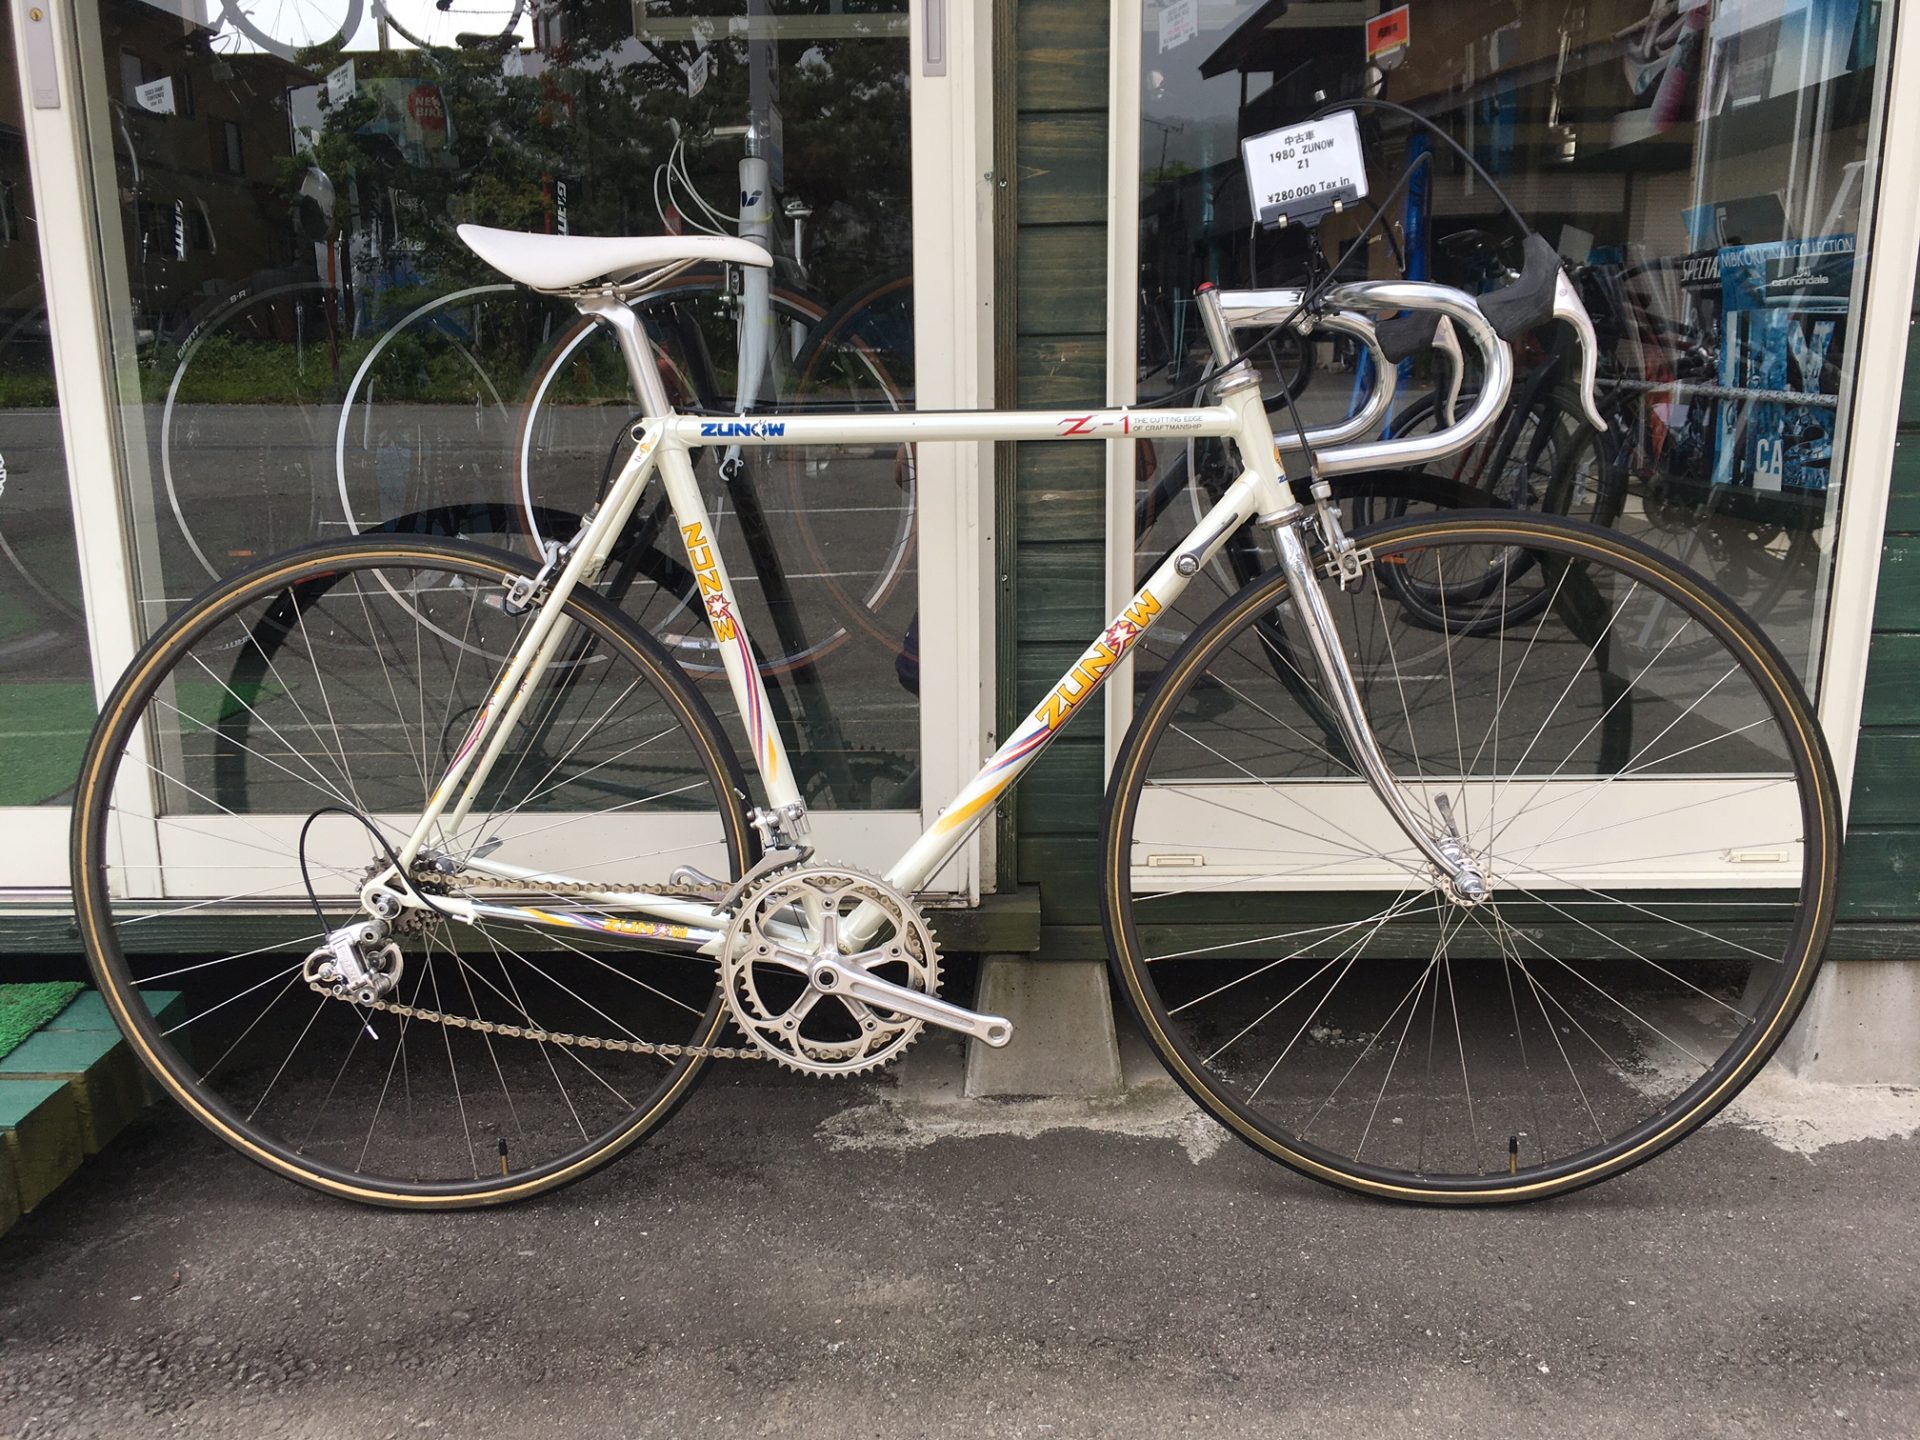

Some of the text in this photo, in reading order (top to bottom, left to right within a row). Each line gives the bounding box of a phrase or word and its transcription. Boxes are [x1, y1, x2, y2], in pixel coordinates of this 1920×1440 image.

[1284, 130, 1315, 146] 中古車
[1269, 138, 1335, 163] 1980 ZUNOW
[1297, 158, 1309, 169] Z1
[1318, 179, 1337, 191] Tax
[1340, 176, 1350, 186] in
[557, 181, 567, 236] GIAN
[1720, 252, 1743, 268] MBK
[1792, 237, 1854, 258] COLLECTION
[1771, 274, 1829, 288] cannondale
[700, 420, 786, 439] ZUNOW
[1133, 415, 1204, 425] THE CUTTING EDGE
[681, 521, 737, 643] ZUNOW
[1034, 588, 1163, 732] ZUNOW
[602, 917, 689, 939] ZUNOW
